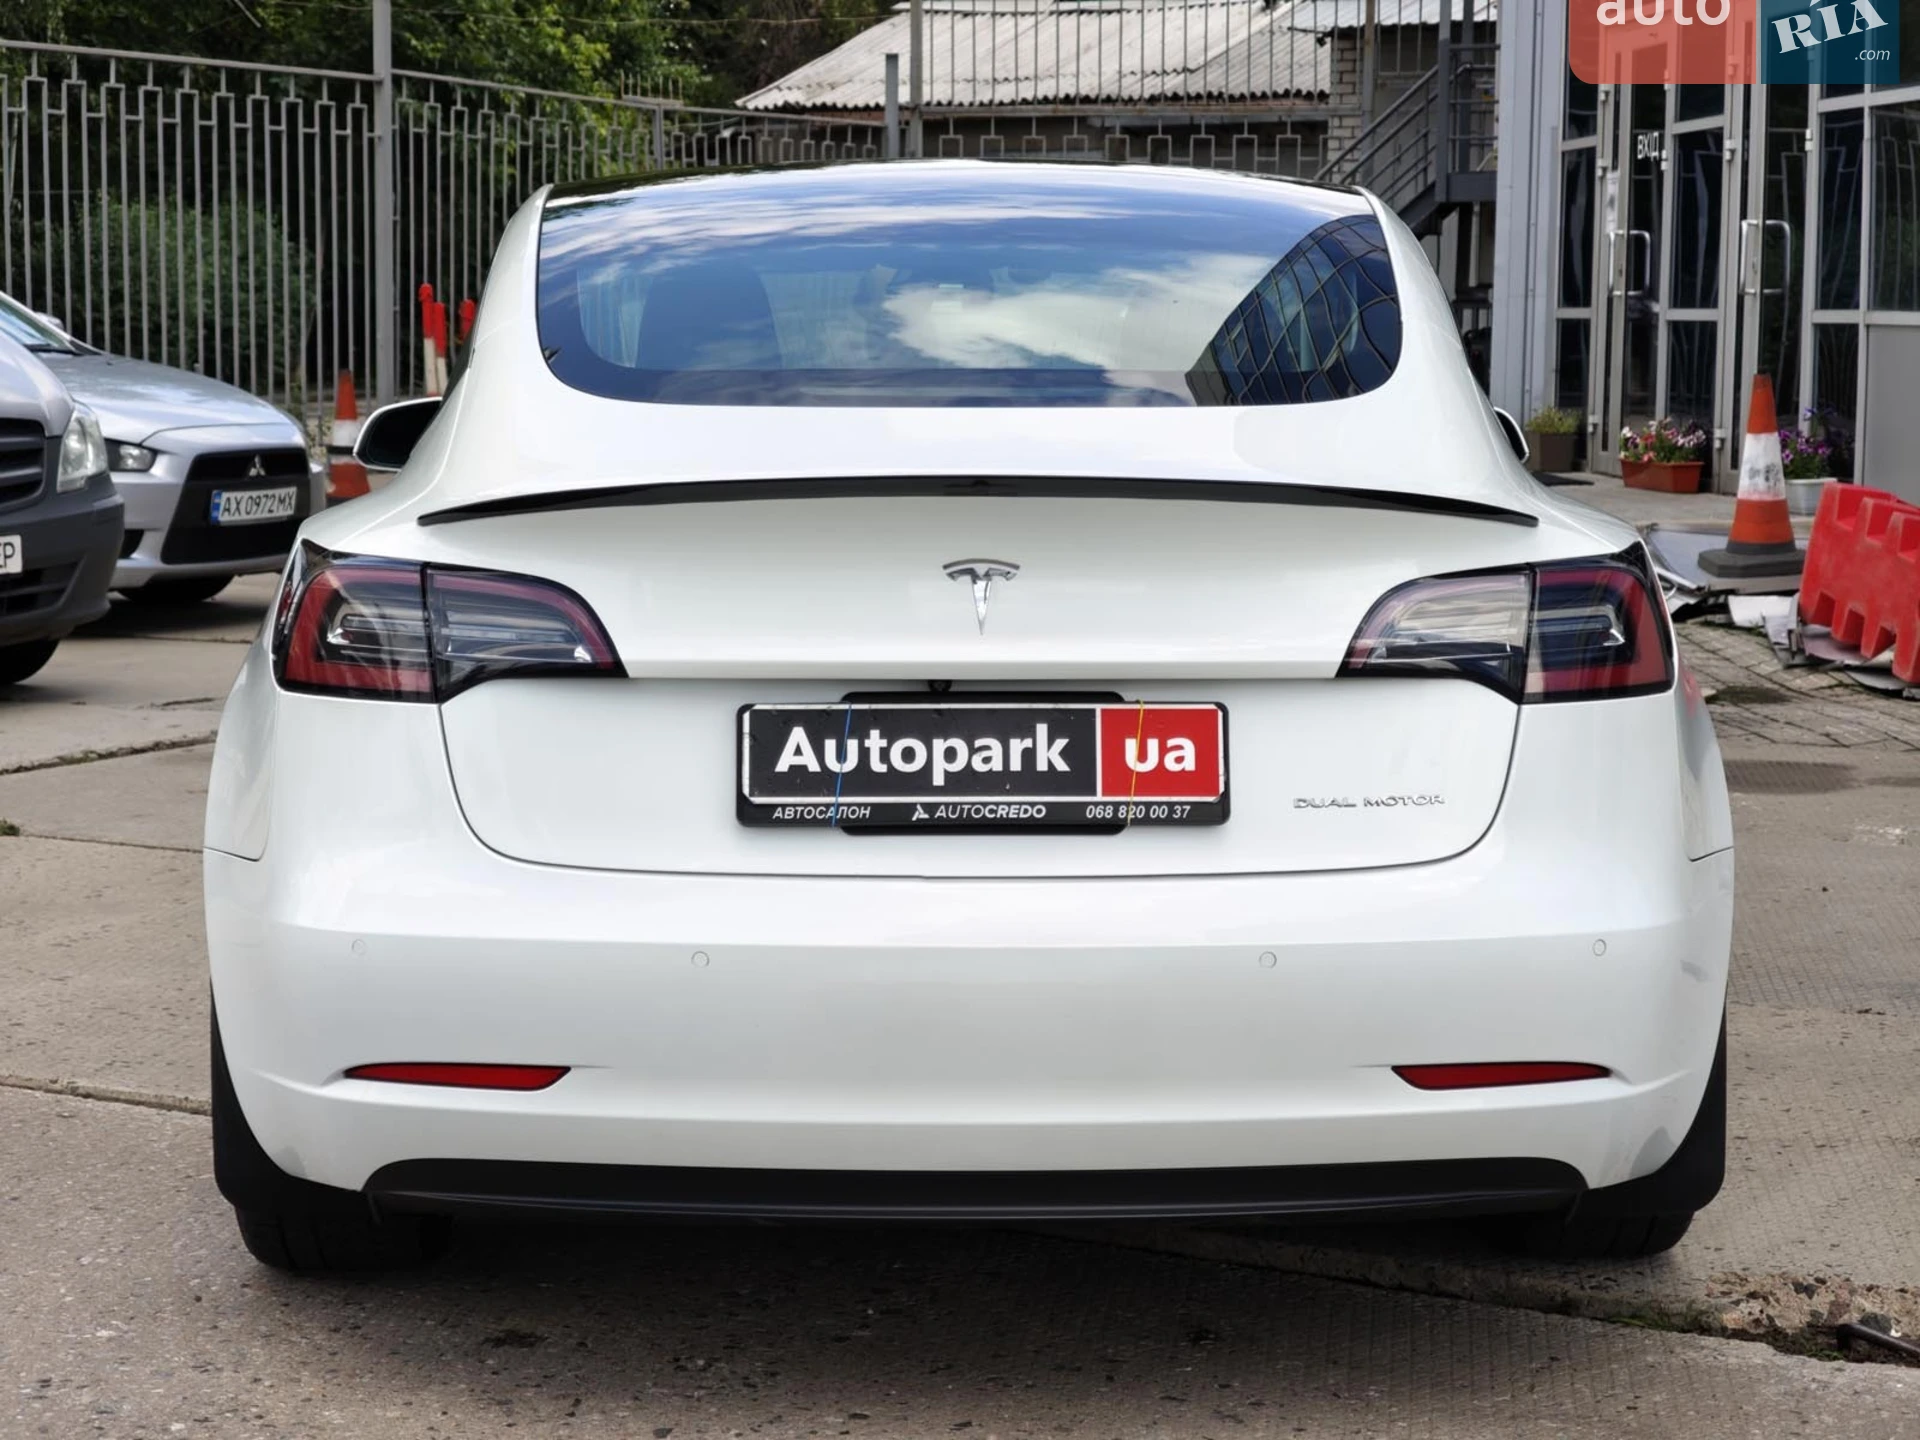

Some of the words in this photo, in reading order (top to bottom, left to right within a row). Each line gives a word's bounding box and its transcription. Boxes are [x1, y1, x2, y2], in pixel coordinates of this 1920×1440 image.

[221, 496, 244, 517] AX
[245, 494, 277, 516] 0972
[277, 491, 295, 512] MX
[774, 724, 1071, 786] Autopark
[1124, 737, 1196, 773] ua
[1293, 797, 1357, 809] DUAL
[1363, 794, 1445, 807] MOTOR
[772, 805, 871, 820] АВТОСАЛОН
[934, 804, 1046, 819] AUTOCREDO
[1085, 804, 1113, 819] 068
[1117, 804, 1145, 819] 820
[1149, 804, 1169, 819] 00
[1172, 804, 1191, 819] 37
